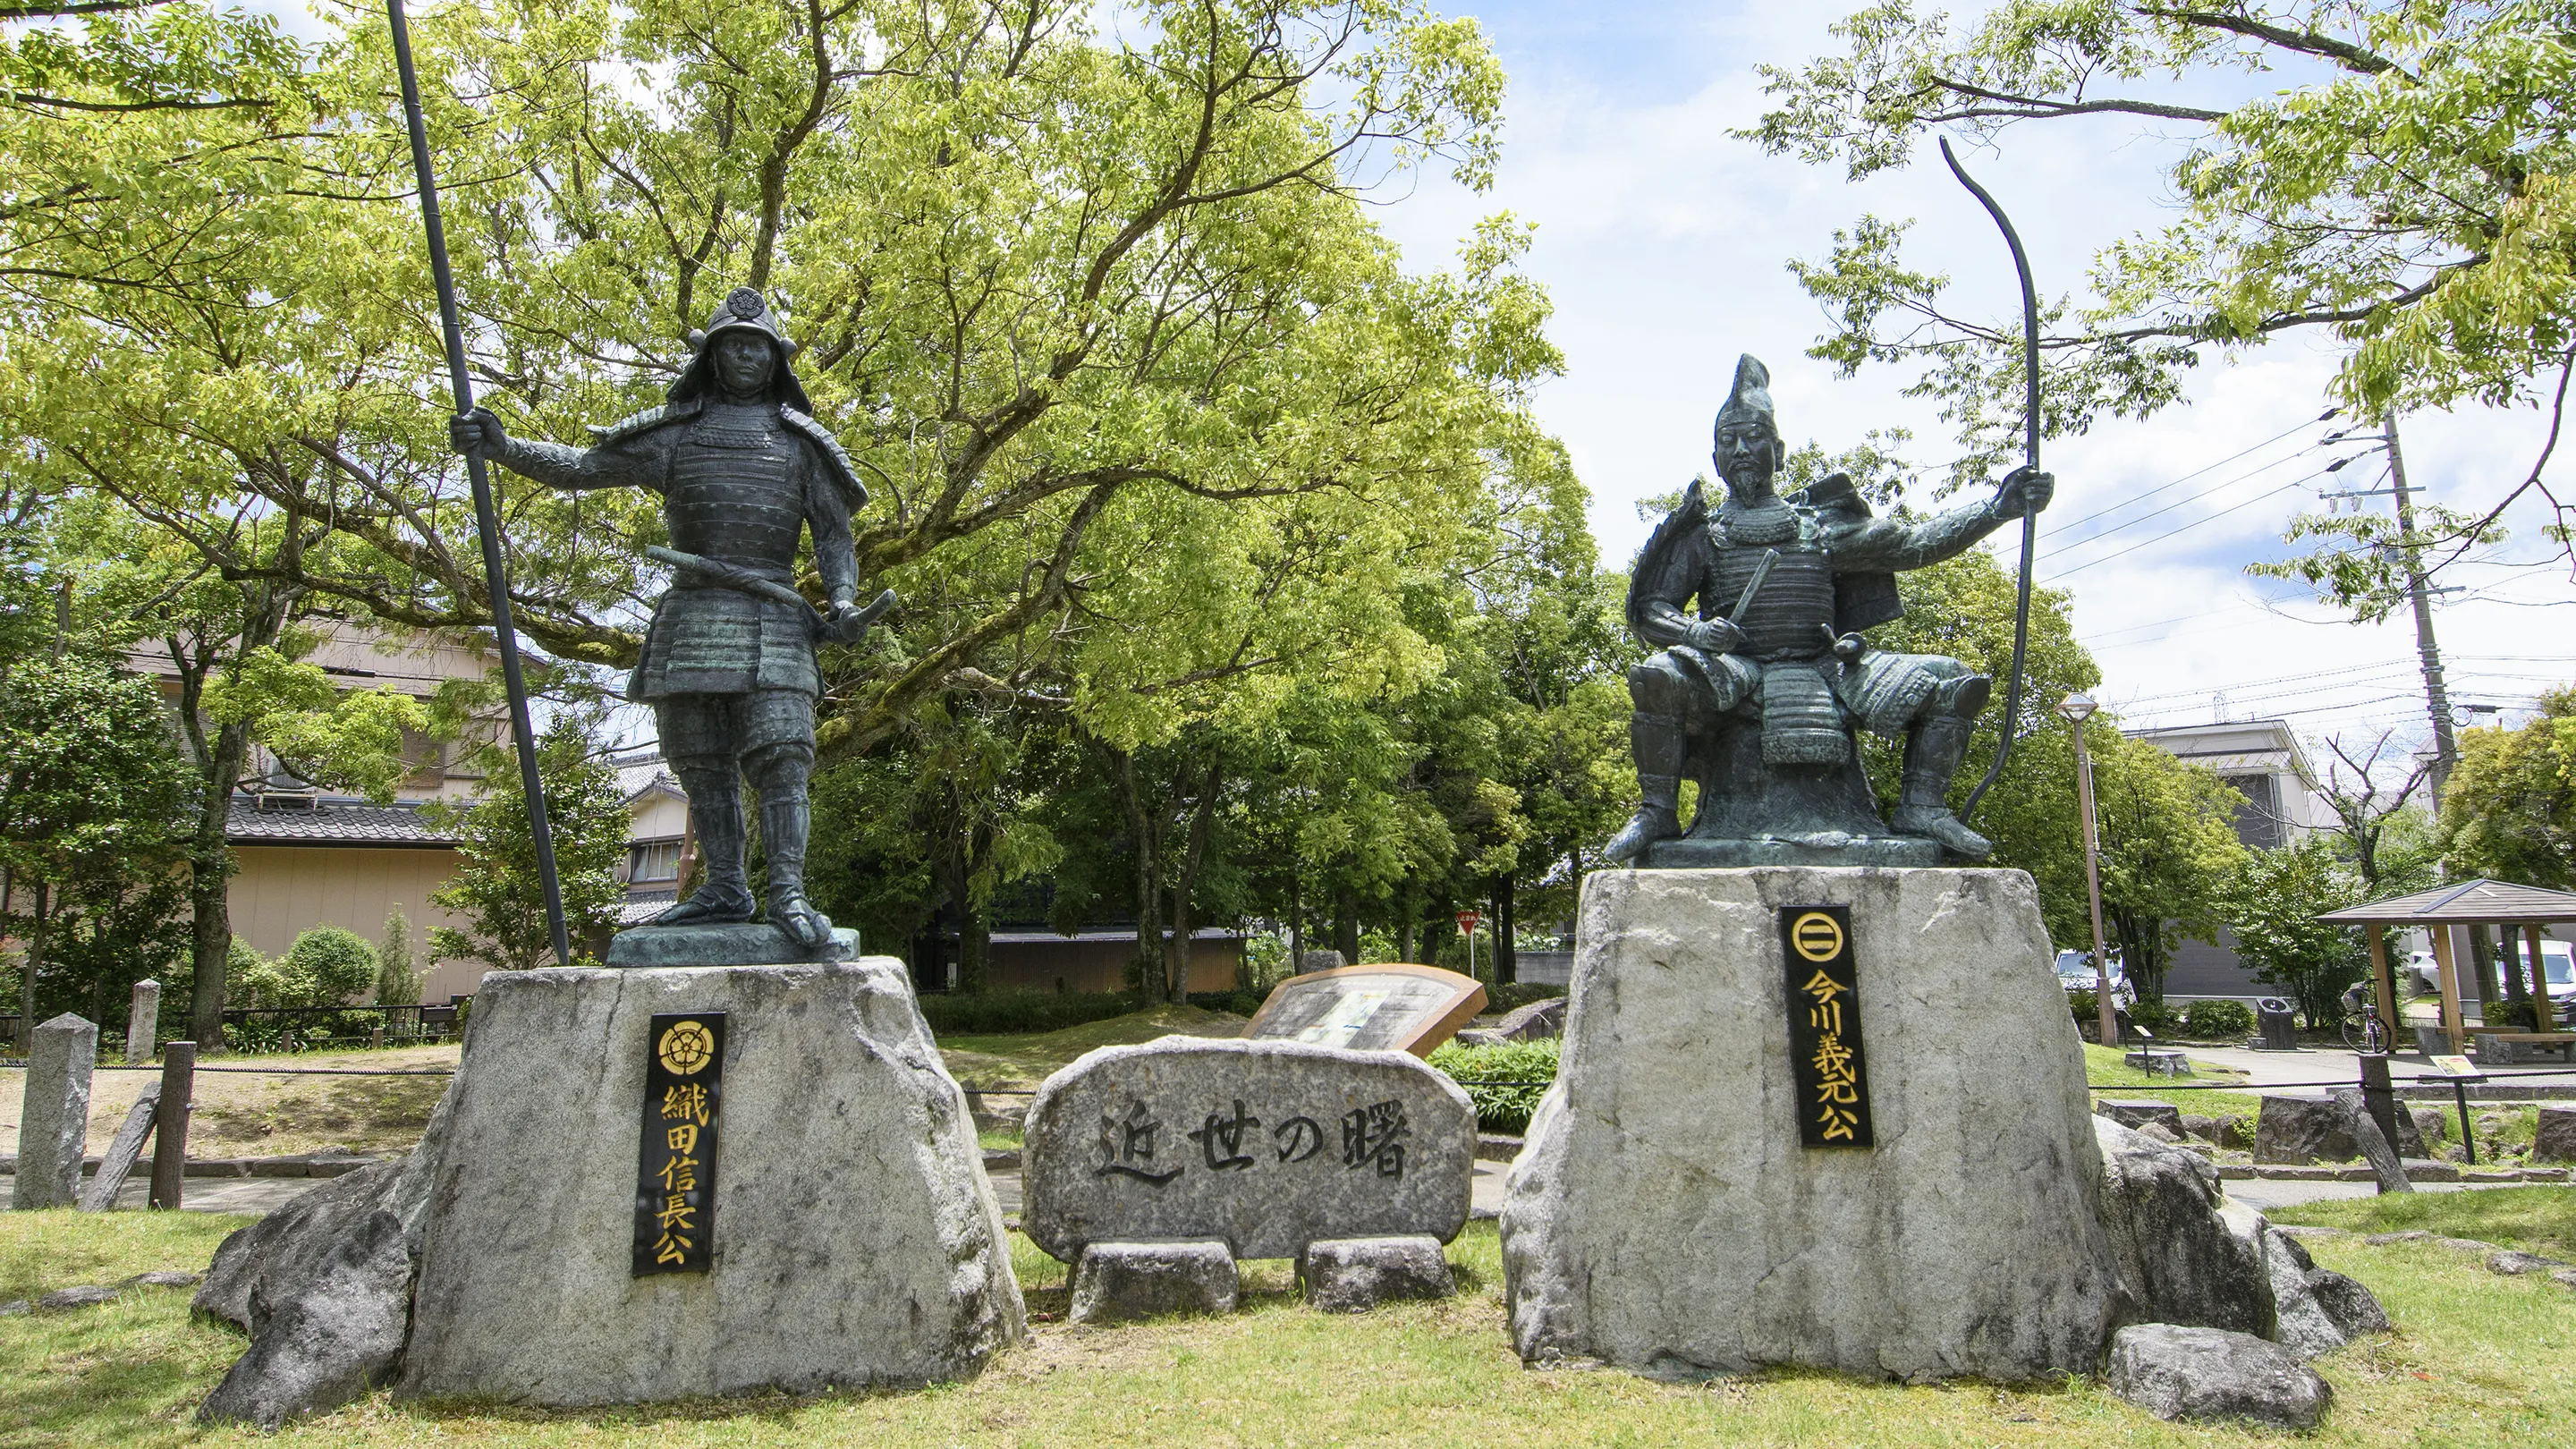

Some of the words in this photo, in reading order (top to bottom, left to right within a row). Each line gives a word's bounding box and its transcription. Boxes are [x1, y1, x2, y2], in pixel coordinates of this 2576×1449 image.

[1801, 969, 1859, 1140] 今川義元公
[651, 1081, 710, 1265] 織田信長公
[1096, 1098, 1411, 1188] 近世の曙
